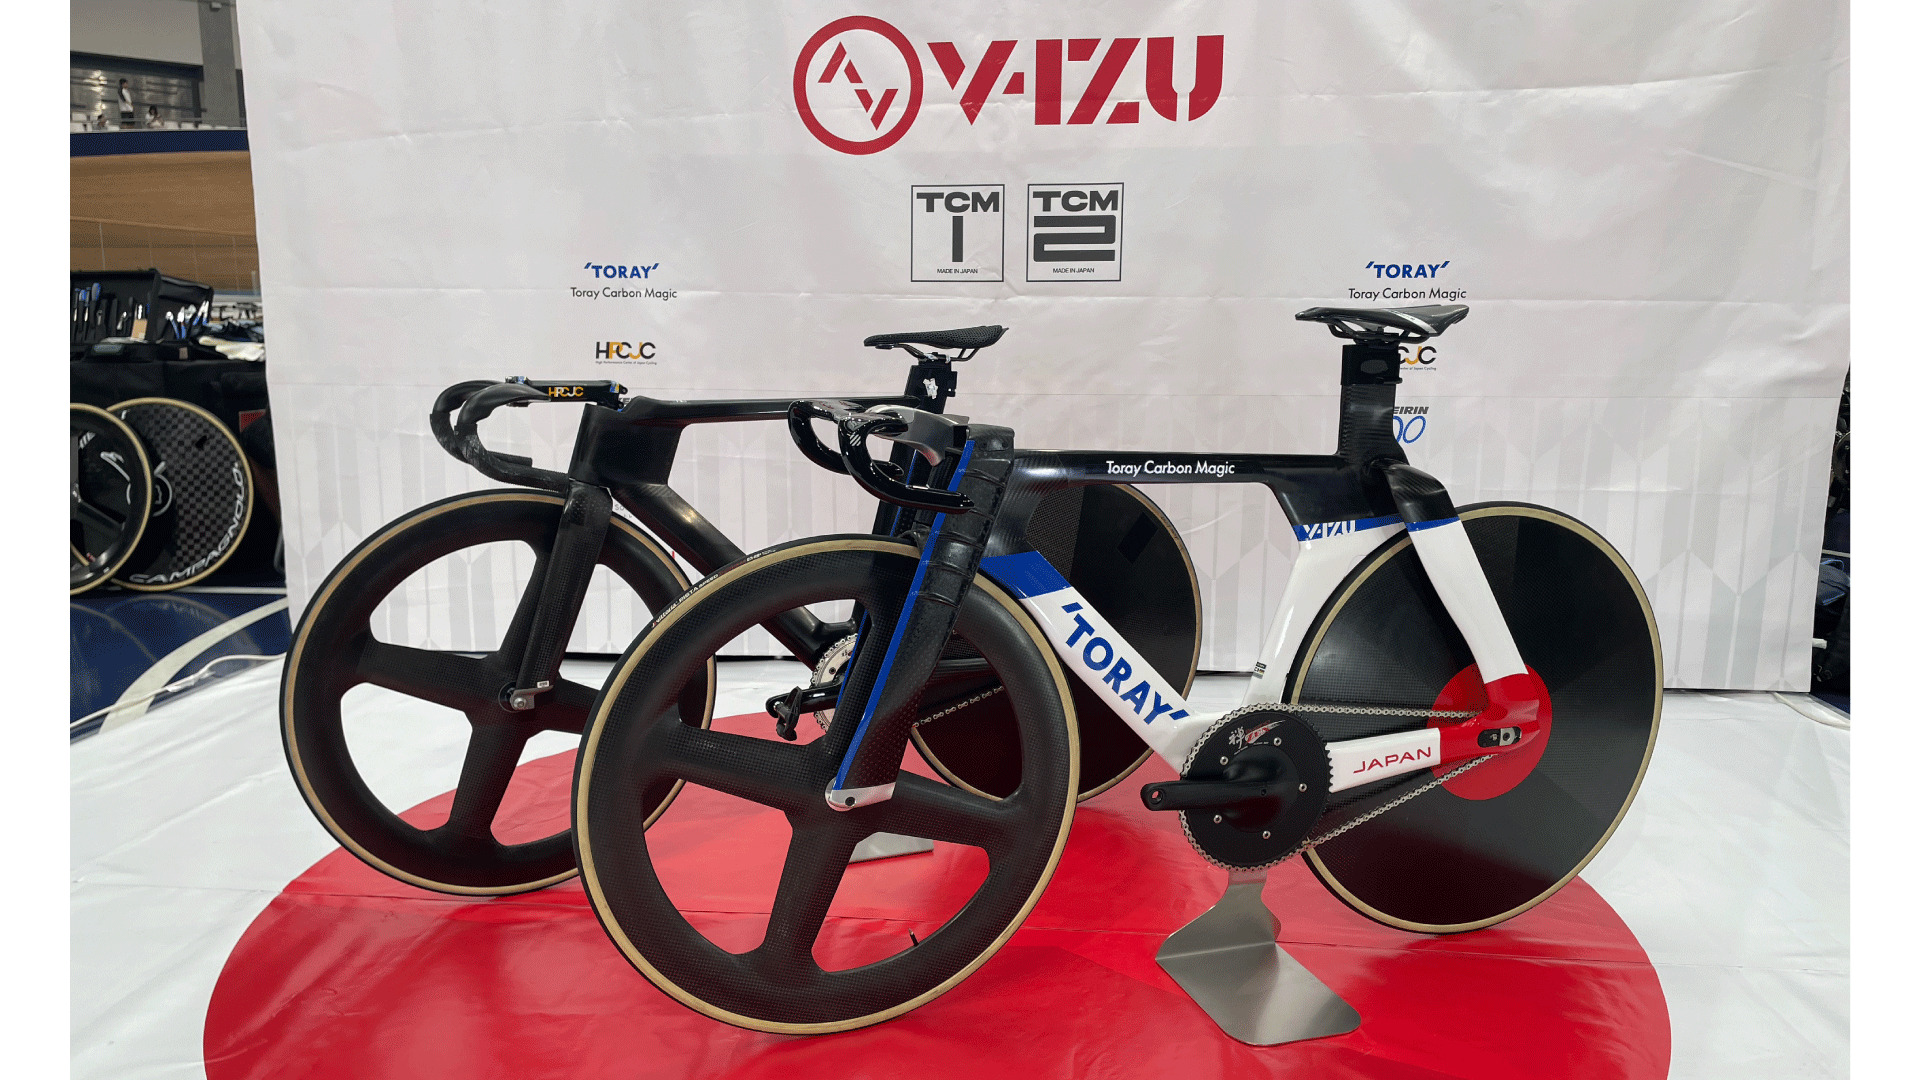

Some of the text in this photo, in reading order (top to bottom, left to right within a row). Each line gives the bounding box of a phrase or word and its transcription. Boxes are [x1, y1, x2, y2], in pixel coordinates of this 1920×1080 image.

[916, 191, 1000, 213] TCM
[1033, 189, 1119, 212] TCM
[951, 215, 964, 263] 1
[1033, 214, 1117, 263] 2
[570, 287, 678, 301] Toray Carbon Magic
[1348, 287, 1467, 301] Toray Carbon Magic
[595, 341, 657, 360] HPCJC
[548, 386, 584, 398] HPCJC
[1393, 406, 1429, 414] EIRIN
[1106, 459, 1235, 478] Toray Carbon Magic
[1353, 746, 1432, 774] JAPAN
